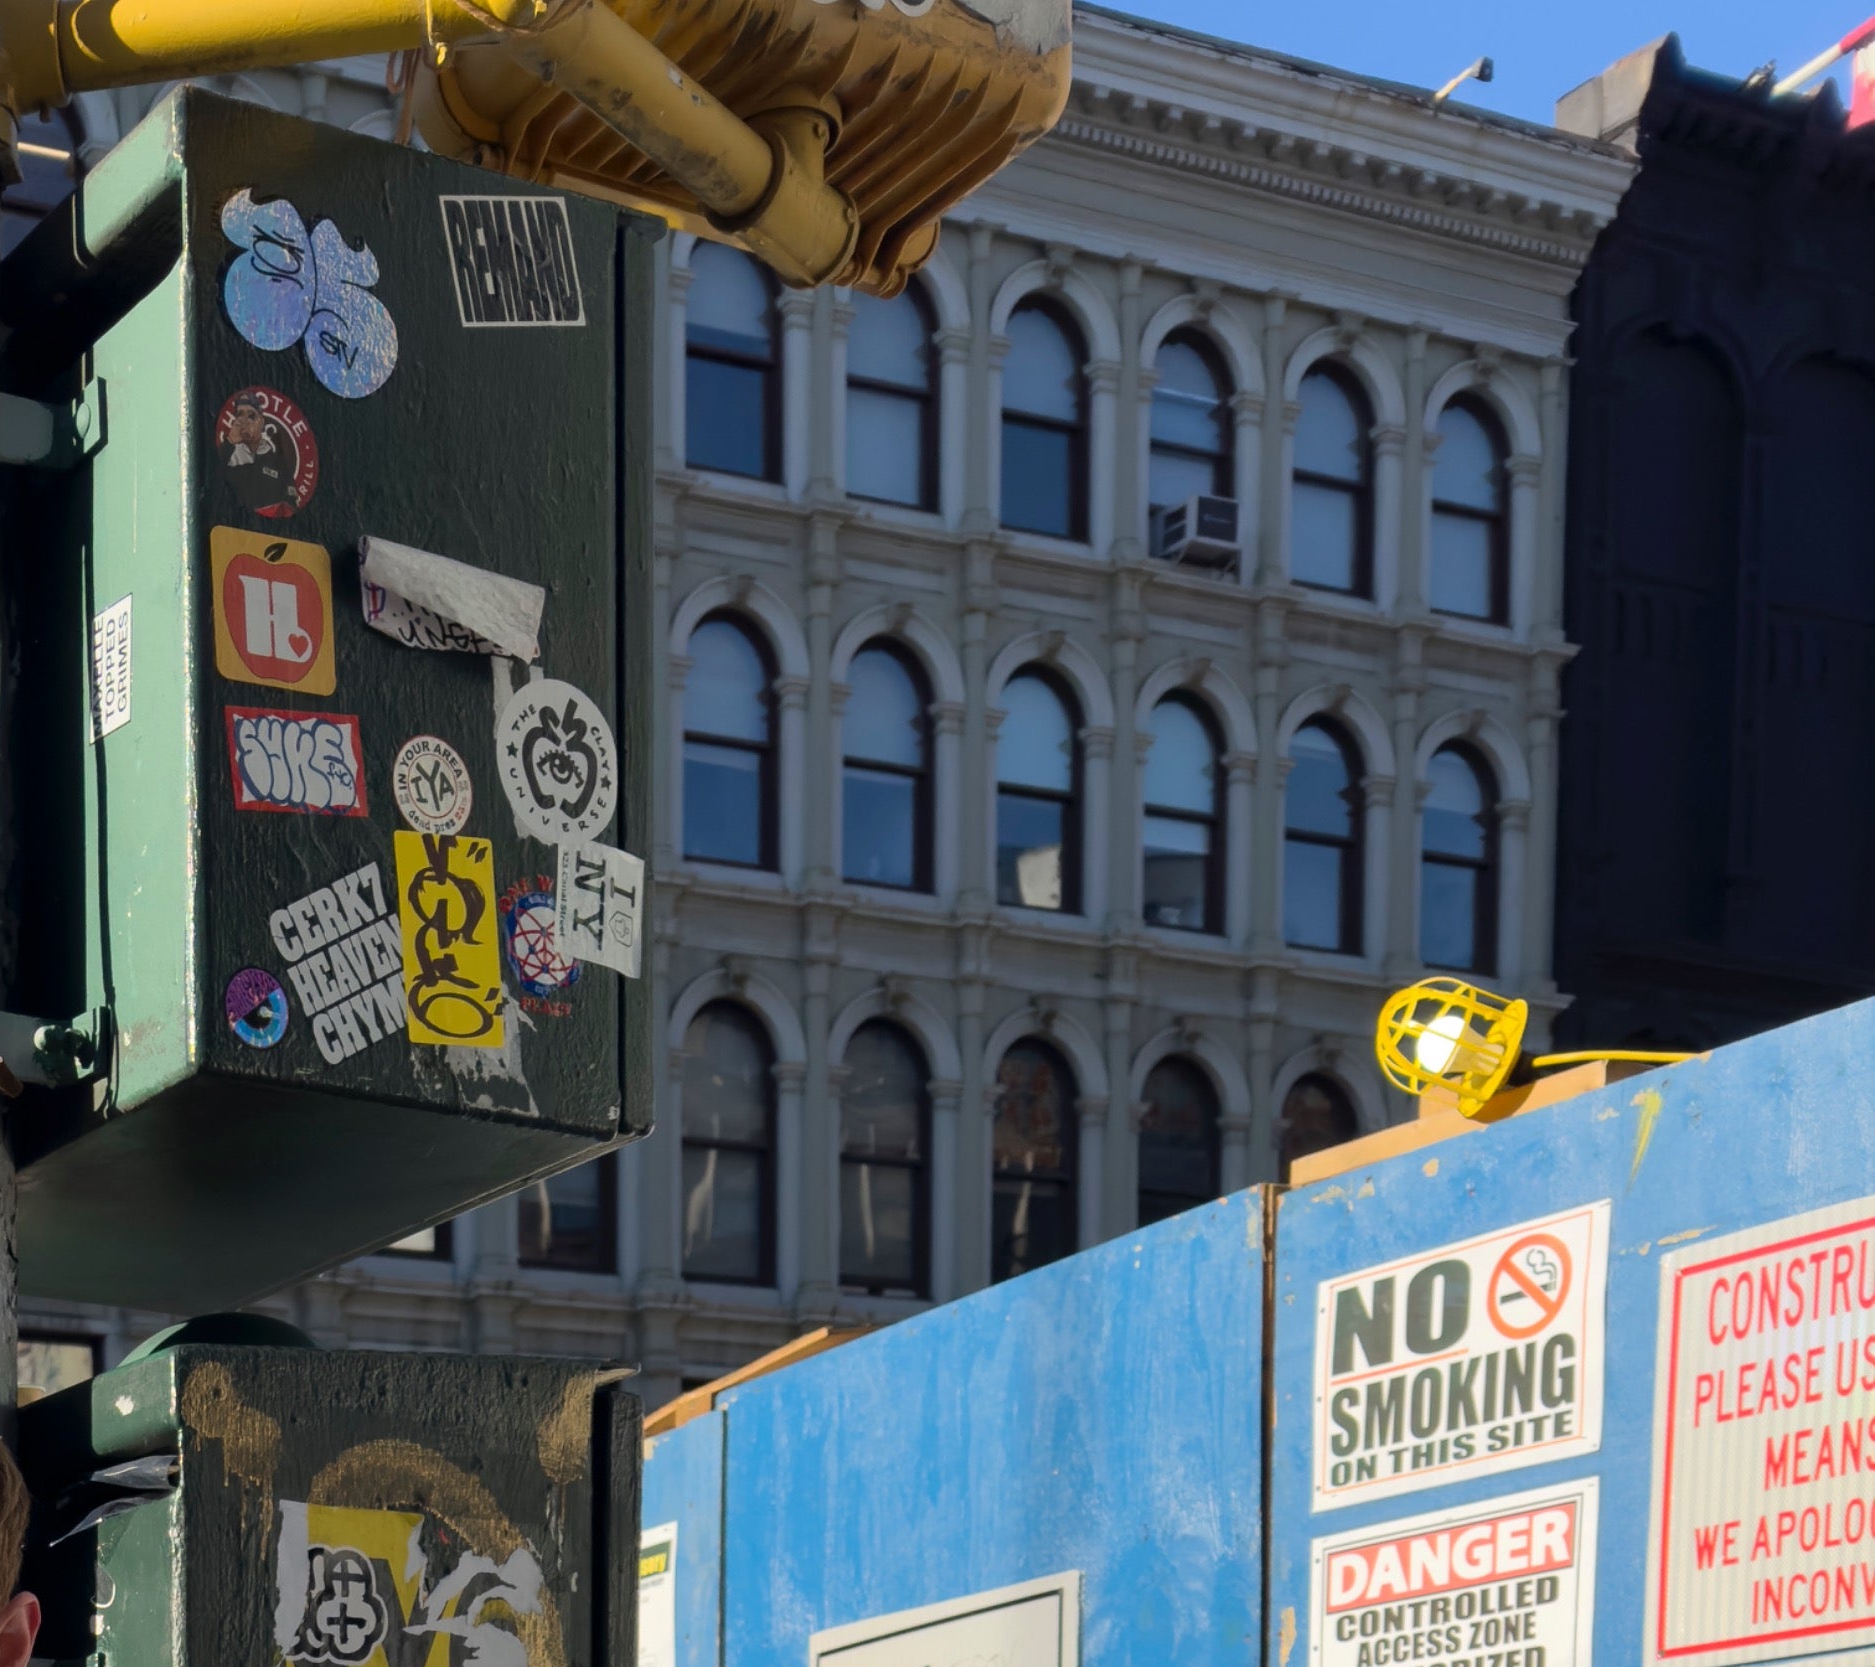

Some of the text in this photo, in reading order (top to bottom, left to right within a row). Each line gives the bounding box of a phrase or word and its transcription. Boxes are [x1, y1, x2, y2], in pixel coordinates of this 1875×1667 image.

[105, 618, 116, 723] TOPPED
[117, 611, 128, 712] GRIMES
[398, 741, 463, 790] IN YOUR AREA
[511, 704, 610, 771] THE CLAY
[574, 851, 606, 950] NY
[287, 913, 404, 1017] HEAVEN
[1332, 1259, 1471, 1376] NO
[1331, 1333, 1576, 1457] SMOKING
[1694, 1346, 1825, 1428] PLEASE
[1331, 1410, 1573, 1486] ON THIS SITE
[1329, 1509, 1570, 1608] DANGER
[1695, 1497, 1875, 1570] WE APOLO
[1336, 1575, 1559, 1642] CONTROLLED
[1469, 1612, 1536, 1650] ZONE
